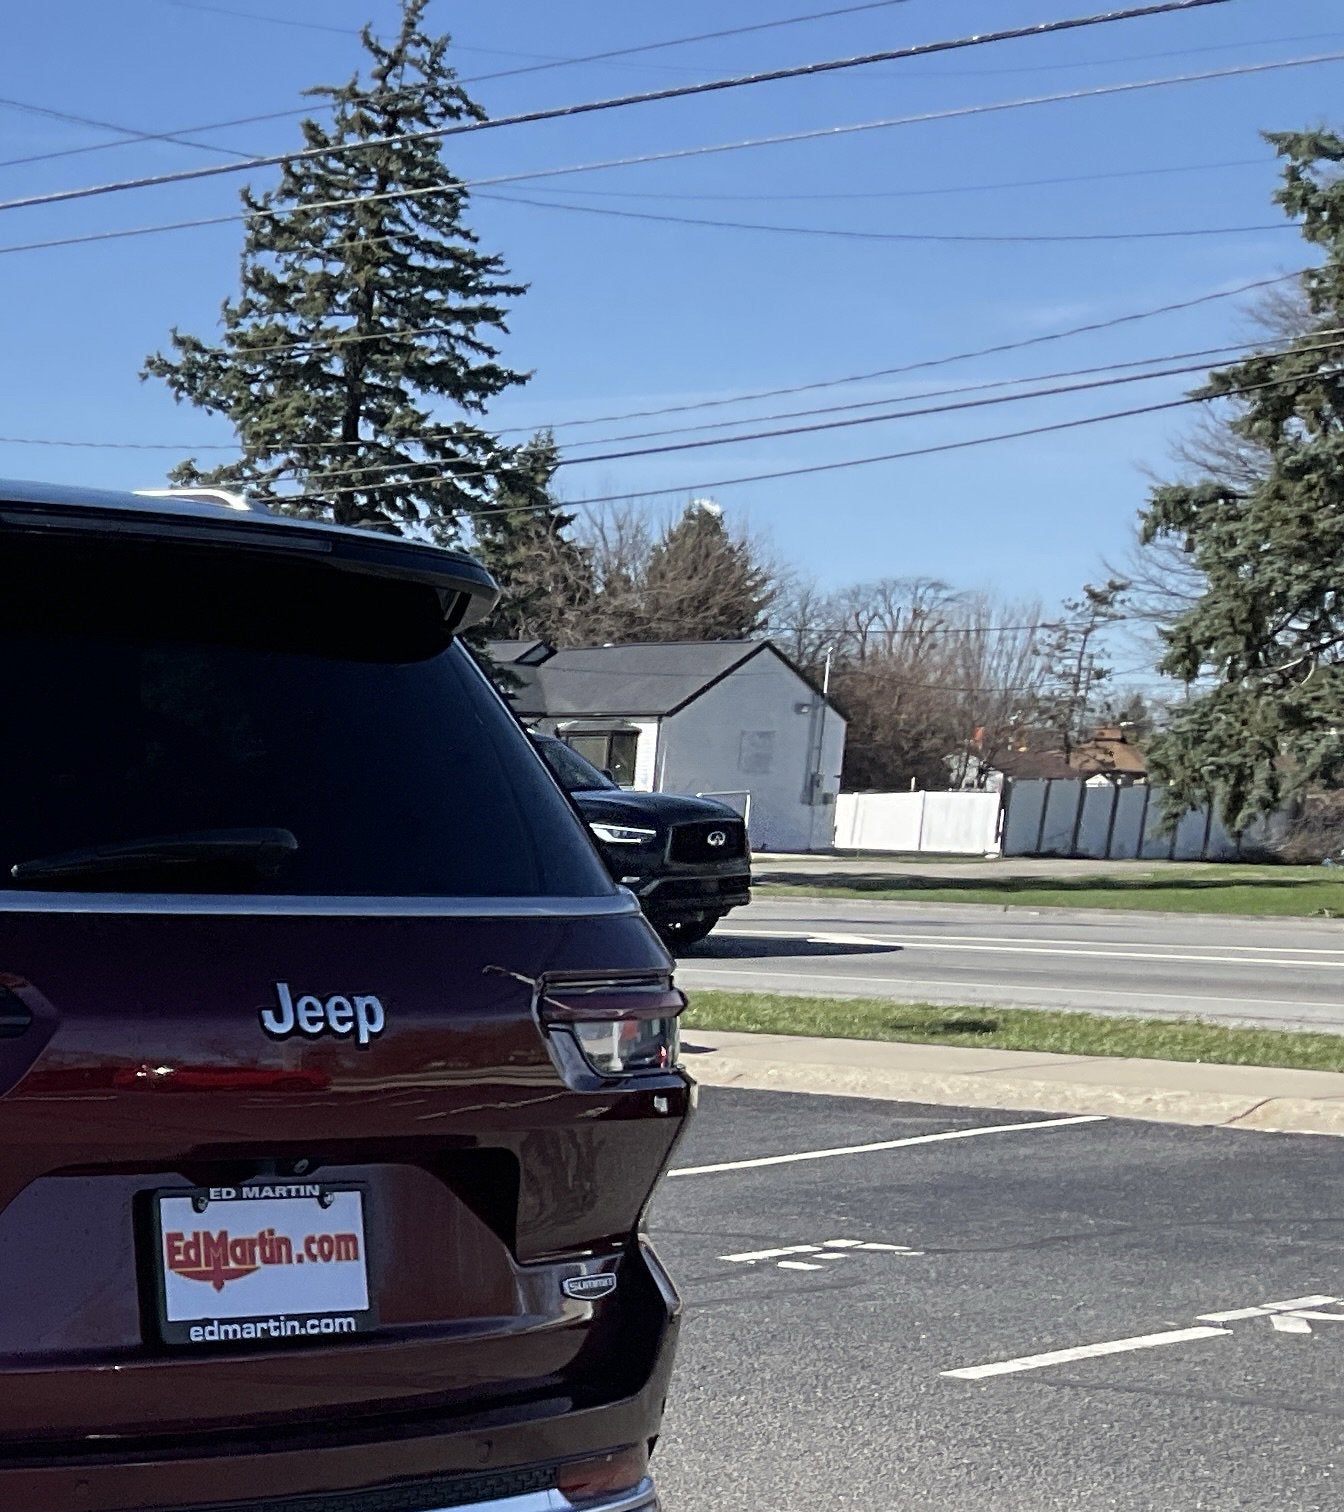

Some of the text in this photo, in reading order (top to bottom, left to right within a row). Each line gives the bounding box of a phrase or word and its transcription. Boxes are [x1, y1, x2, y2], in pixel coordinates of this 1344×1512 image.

[261, 982, 385, 1044] Jeep
[209, 1184, 321, 1200] ED MARTIN
[165, 1228, 360, 1272] EdMartin.com
[188, 1315, 357, 1342] edmartin.com
